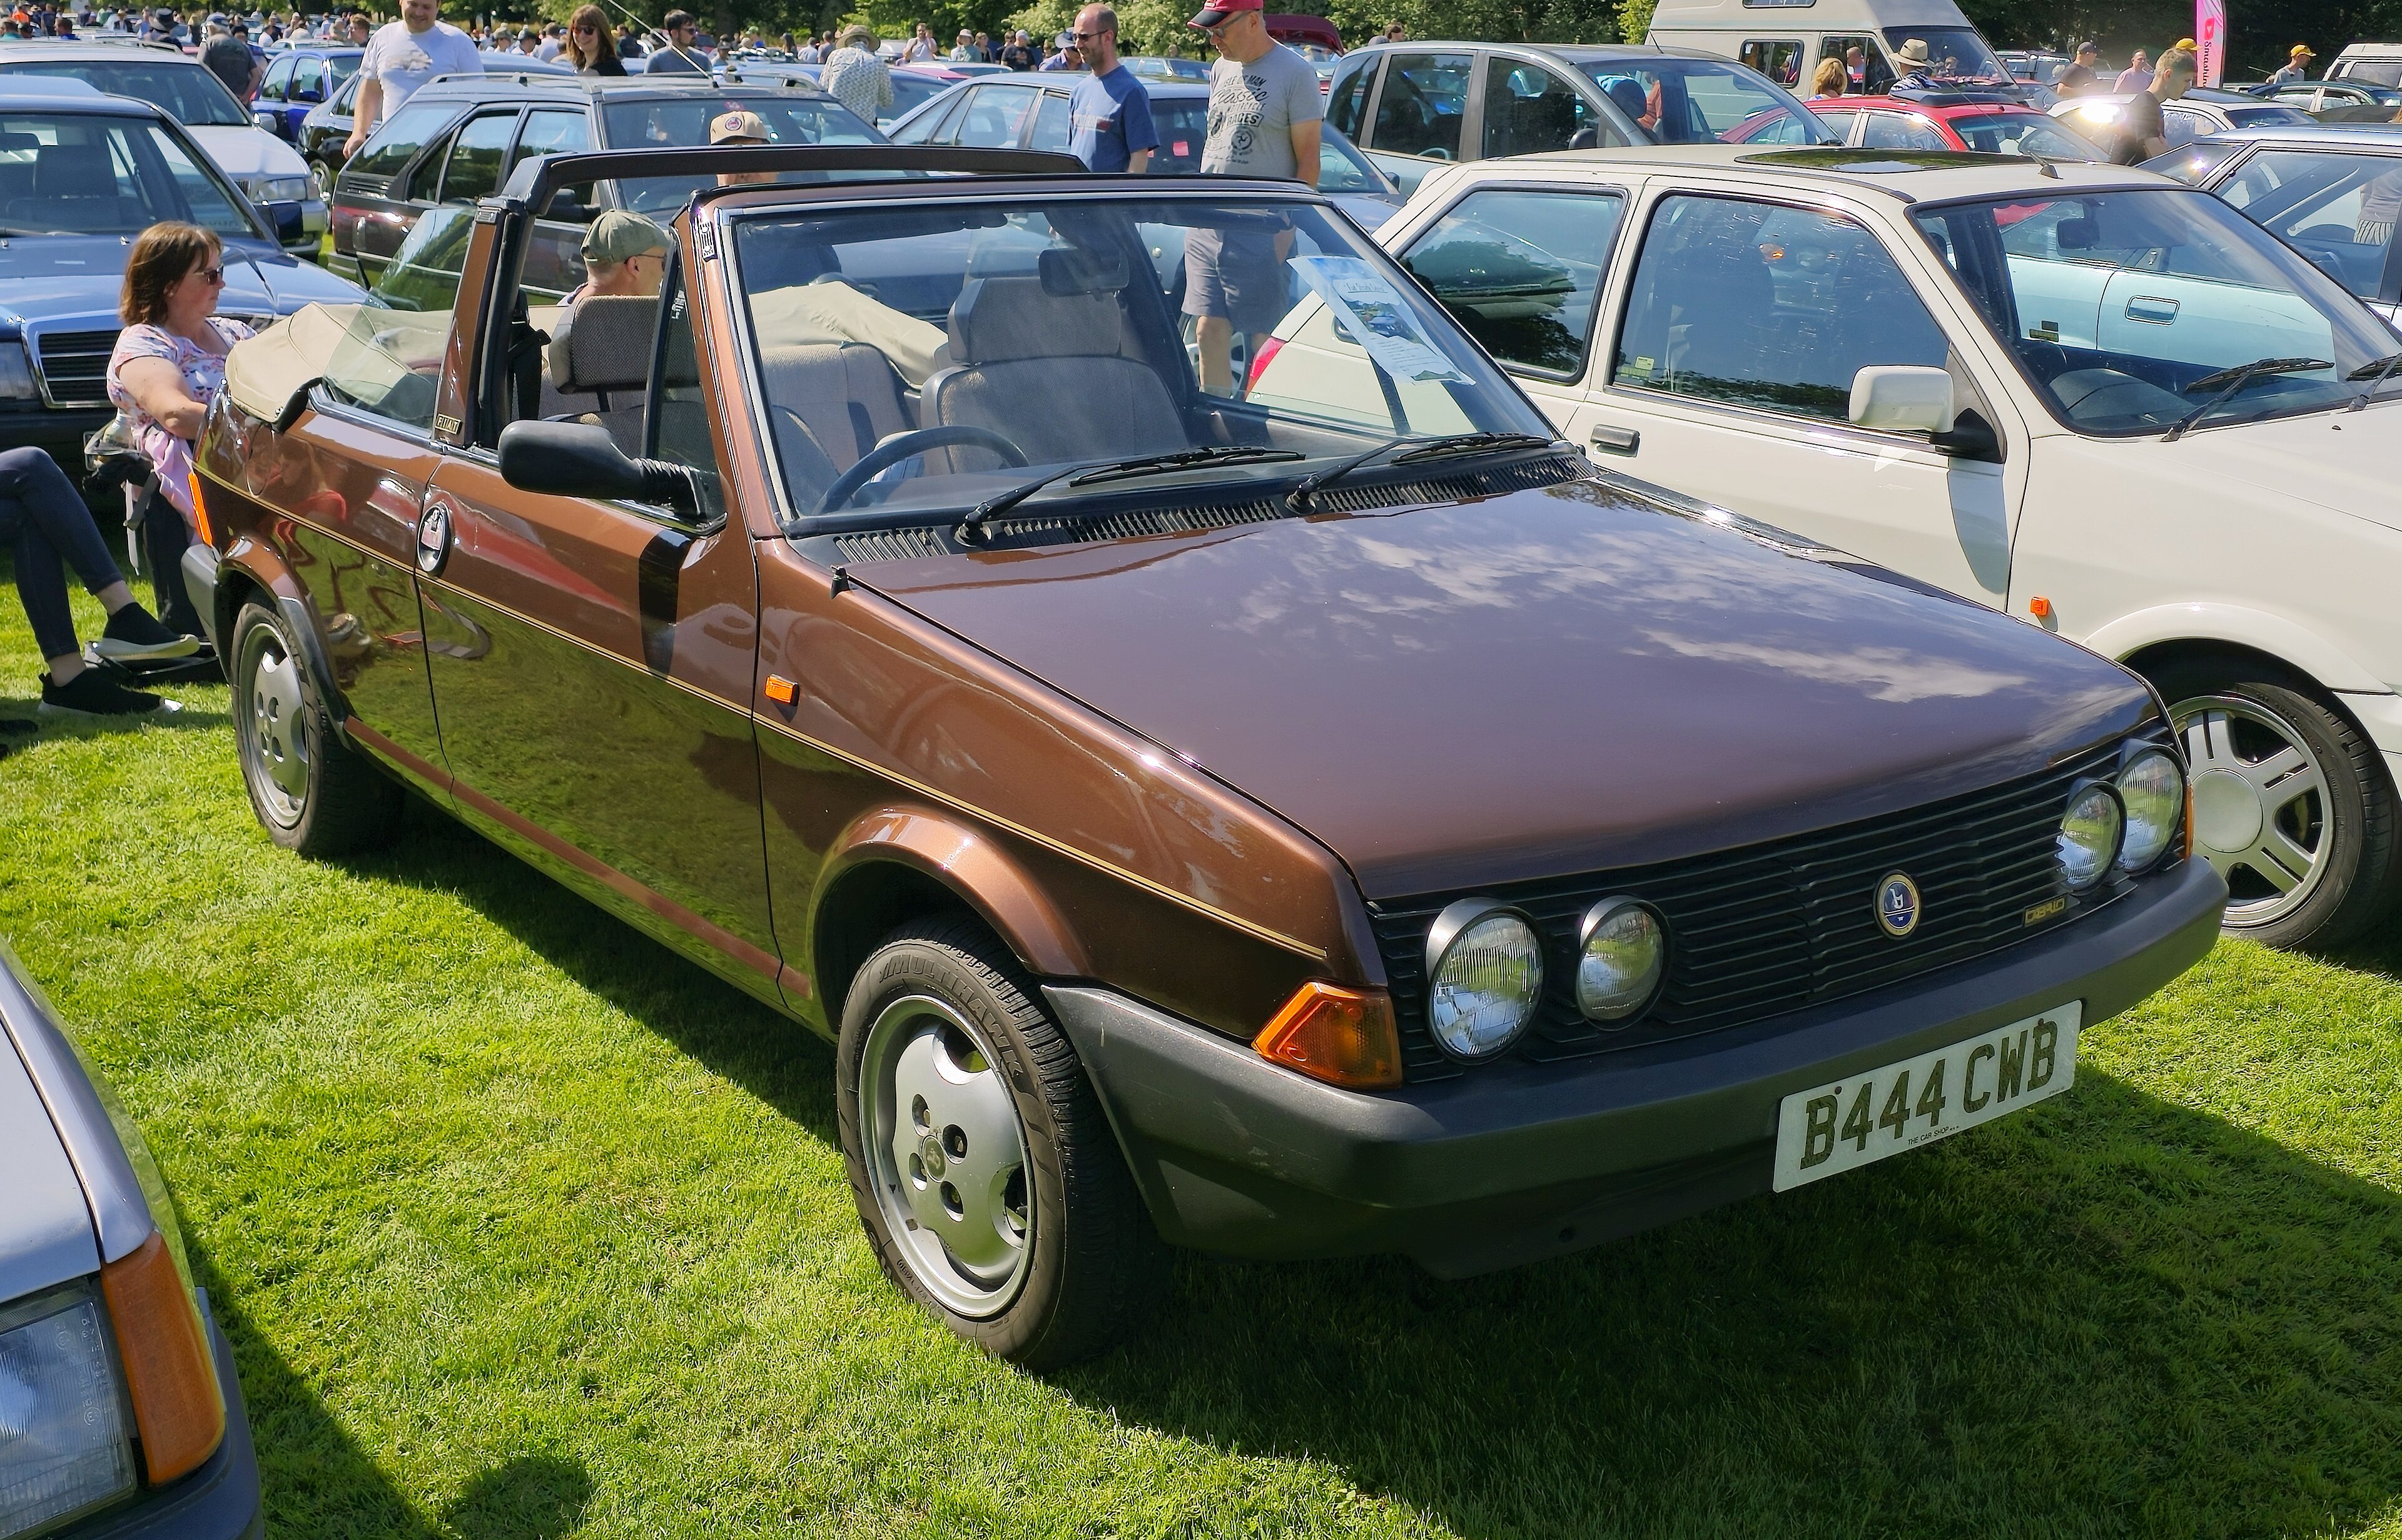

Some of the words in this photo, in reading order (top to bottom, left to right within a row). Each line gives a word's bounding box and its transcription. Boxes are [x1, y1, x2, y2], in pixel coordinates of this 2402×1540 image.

[2202, 41, 2212, 86] Smashin
[1247, 75, 1267, 88] MAN
[1227, 113, 1259, 126] RACES
[437, 416, 459, 432] FIAT
[881, 954, 1024, 1078] MULTIHAWK
[1800, 1058, 1947, 1170] B444
[1963, 1020, 2059, 1114] CWB
[1908, 1136, 1918, 1145] THE
[1920, 1132, 1932, 1141] CAR
[1933, 1126, 1949, 1137] SHOP
